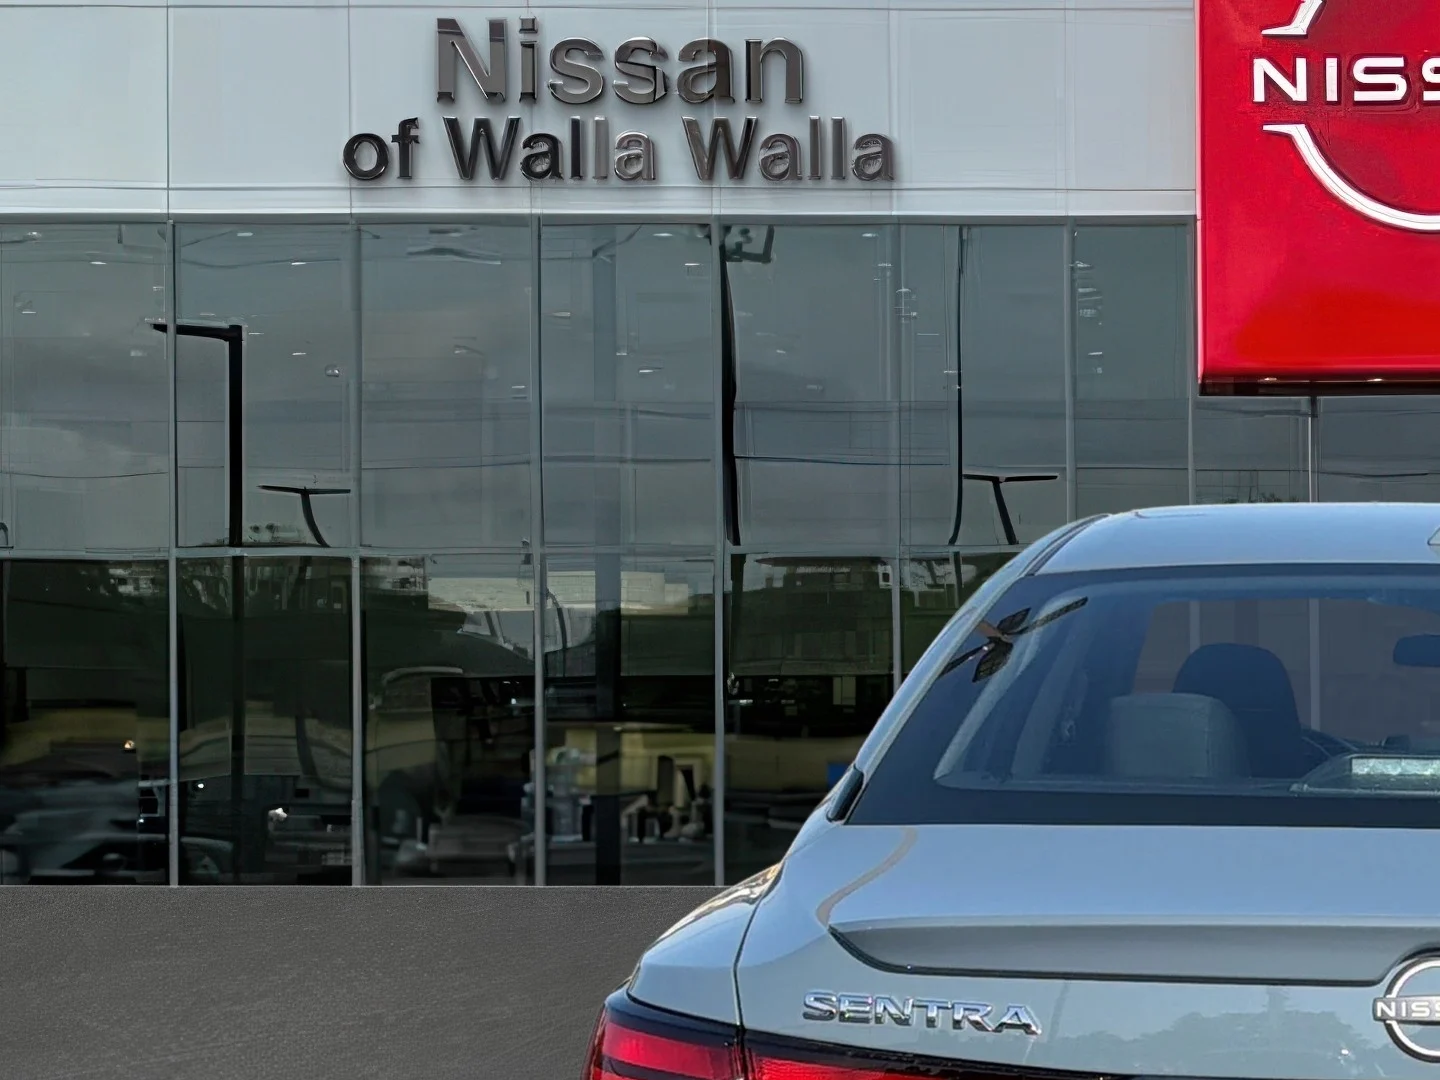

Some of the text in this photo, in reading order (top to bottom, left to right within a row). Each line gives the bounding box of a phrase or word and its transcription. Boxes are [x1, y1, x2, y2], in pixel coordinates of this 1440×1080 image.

[436, 18, 804, 103] Nissan
[342, 116, 895, 181] of Walla Walla
[803, 989, 1042, 1036] SENTRA
